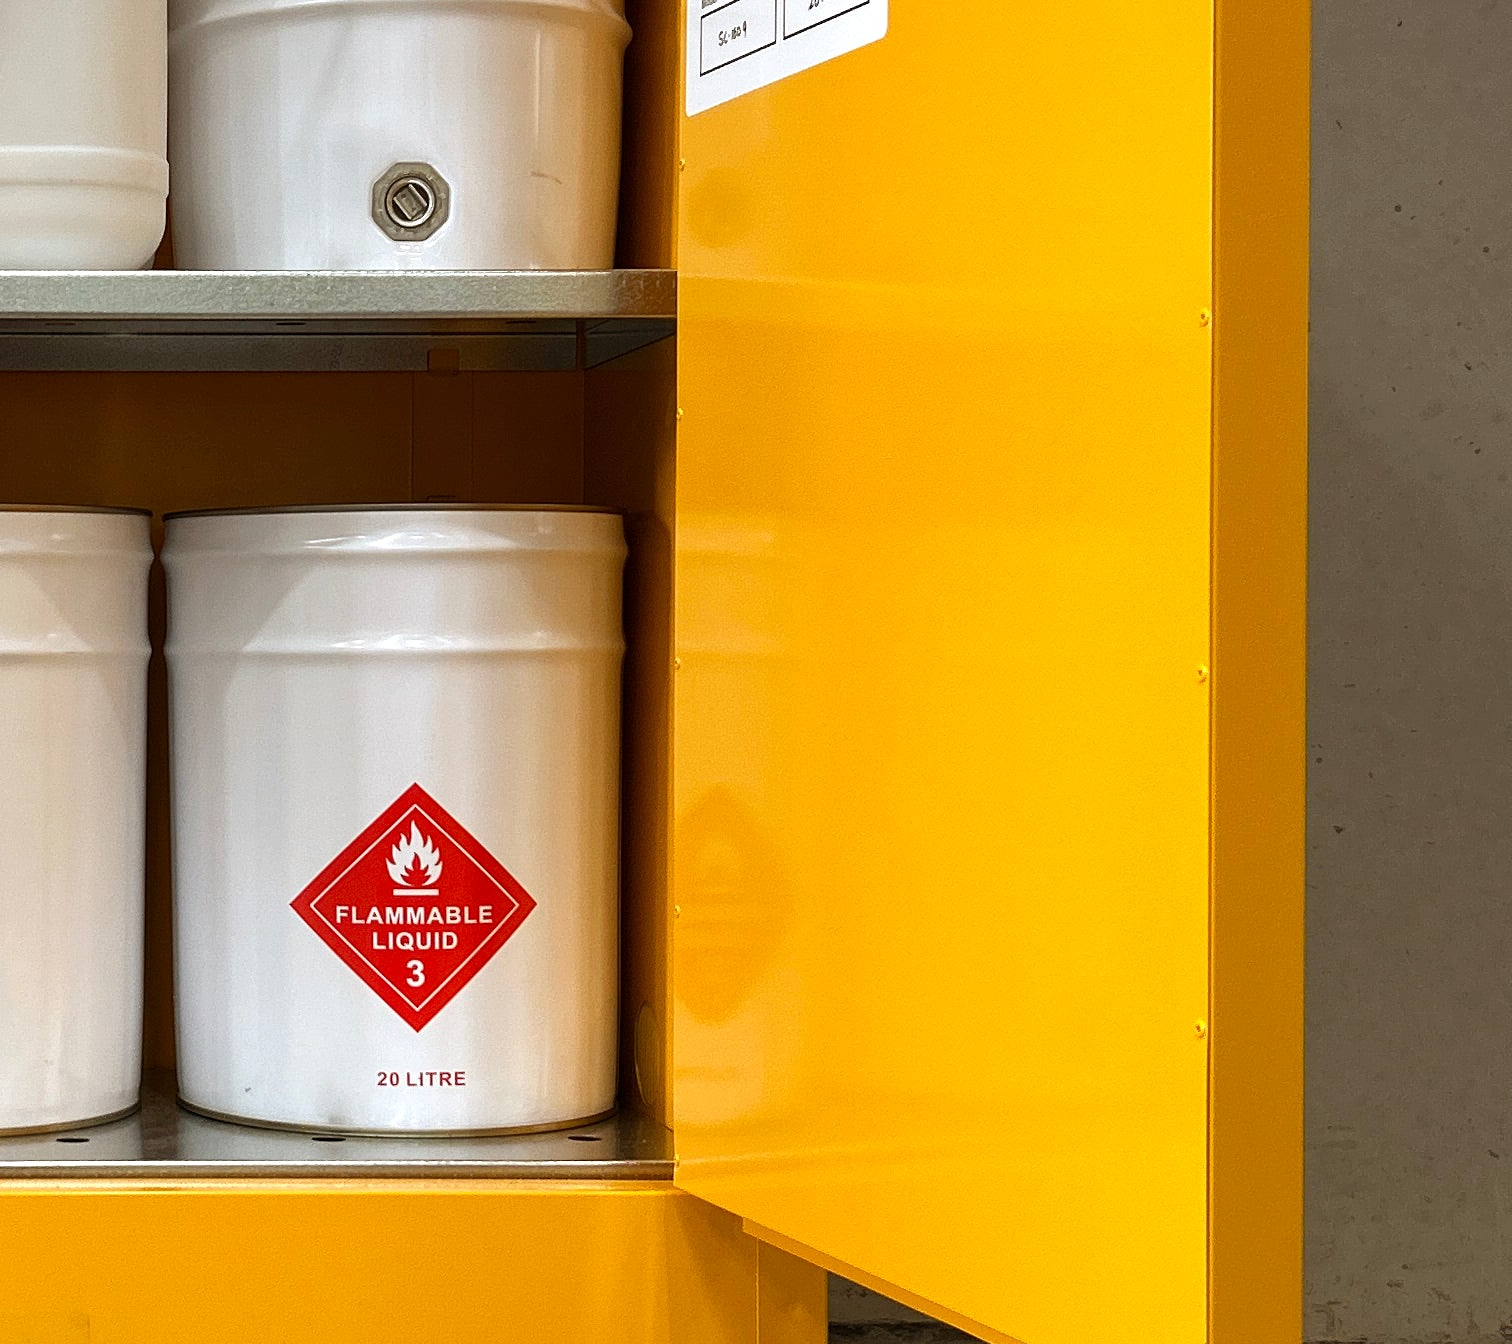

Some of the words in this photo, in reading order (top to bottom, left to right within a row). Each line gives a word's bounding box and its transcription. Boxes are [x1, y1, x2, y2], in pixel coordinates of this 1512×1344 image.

[335, 905, 493, 925] FLAMMABLE
[372, 931, 458, 952] LIQUID
[406, 959, 426, 988] 3
[377, 1071, 400, 1087] 20
[406, 1071, 467, 1087] LITRE
